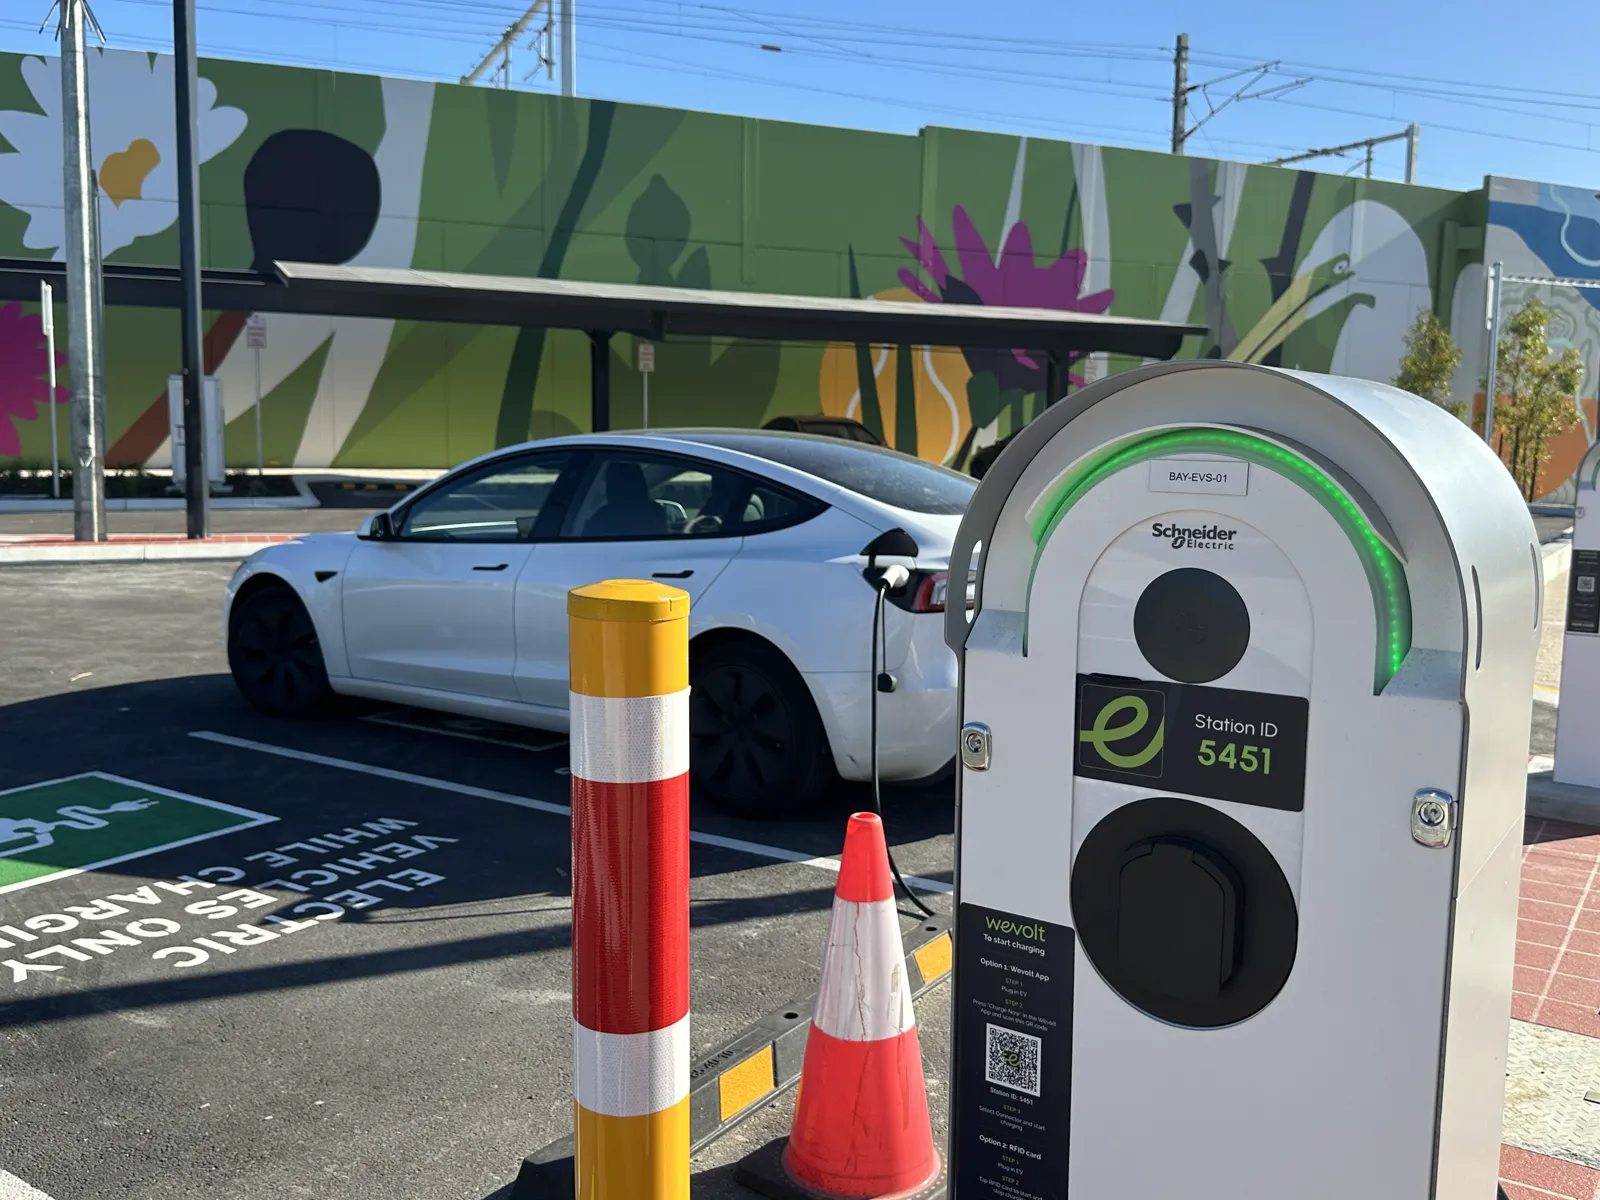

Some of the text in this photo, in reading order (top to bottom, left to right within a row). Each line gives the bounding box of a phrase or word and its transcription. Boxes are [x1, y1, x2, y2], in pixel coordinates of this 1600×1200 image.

[1168, 471, 1228, 483] BAY-EVS-01
[1152, 522, 1238, 543] Schneider
[1187, 539, 1235, 550] Electric
[1194, 714, 1278, 737] Station ID
[1197, 739, 1272, 775] 5451
[0, 817, 419, 949] WHILE CHARGI
[1, 833, 460, 983] VEHICLES ONLY
[152, 867, 446, 968] ELECTRIC
[985, 916, 1046, 942] wevolt
[983, 933, 1046, 957] To start charging
[980, 957, 1003, 969] Option
[1010, 965, 1034, 978] Wevolt
[1035, 972, 1050, 983] App
[1001, 985, 1013, 995] Plug
[1005, 977, 1019, 986] STEP
[1004, 998, 1018, 1007] STEP
[980, 1008, 991, 1016] App
[992, 1011, 1002, 1019] and
[1002, 1014, 1015, 1022] scan
[1034, 1022, 1049, 1032] code
[1028, 1014, 1037, 1022] the
[989, 1086, 1010, 1099] Station
[1019, 1095, 1034, 1105] 5451
[1022, 1119, 1033, 1127] and
[1033, 1123, 1046, 1132] start
[979, 1134, 1002, 1147] Option
[1009, 1143, 1025, 1155] RFID
[1025, 1150, 1042, 1160] card
[1001, 1154, 1016, 1163] STEP
